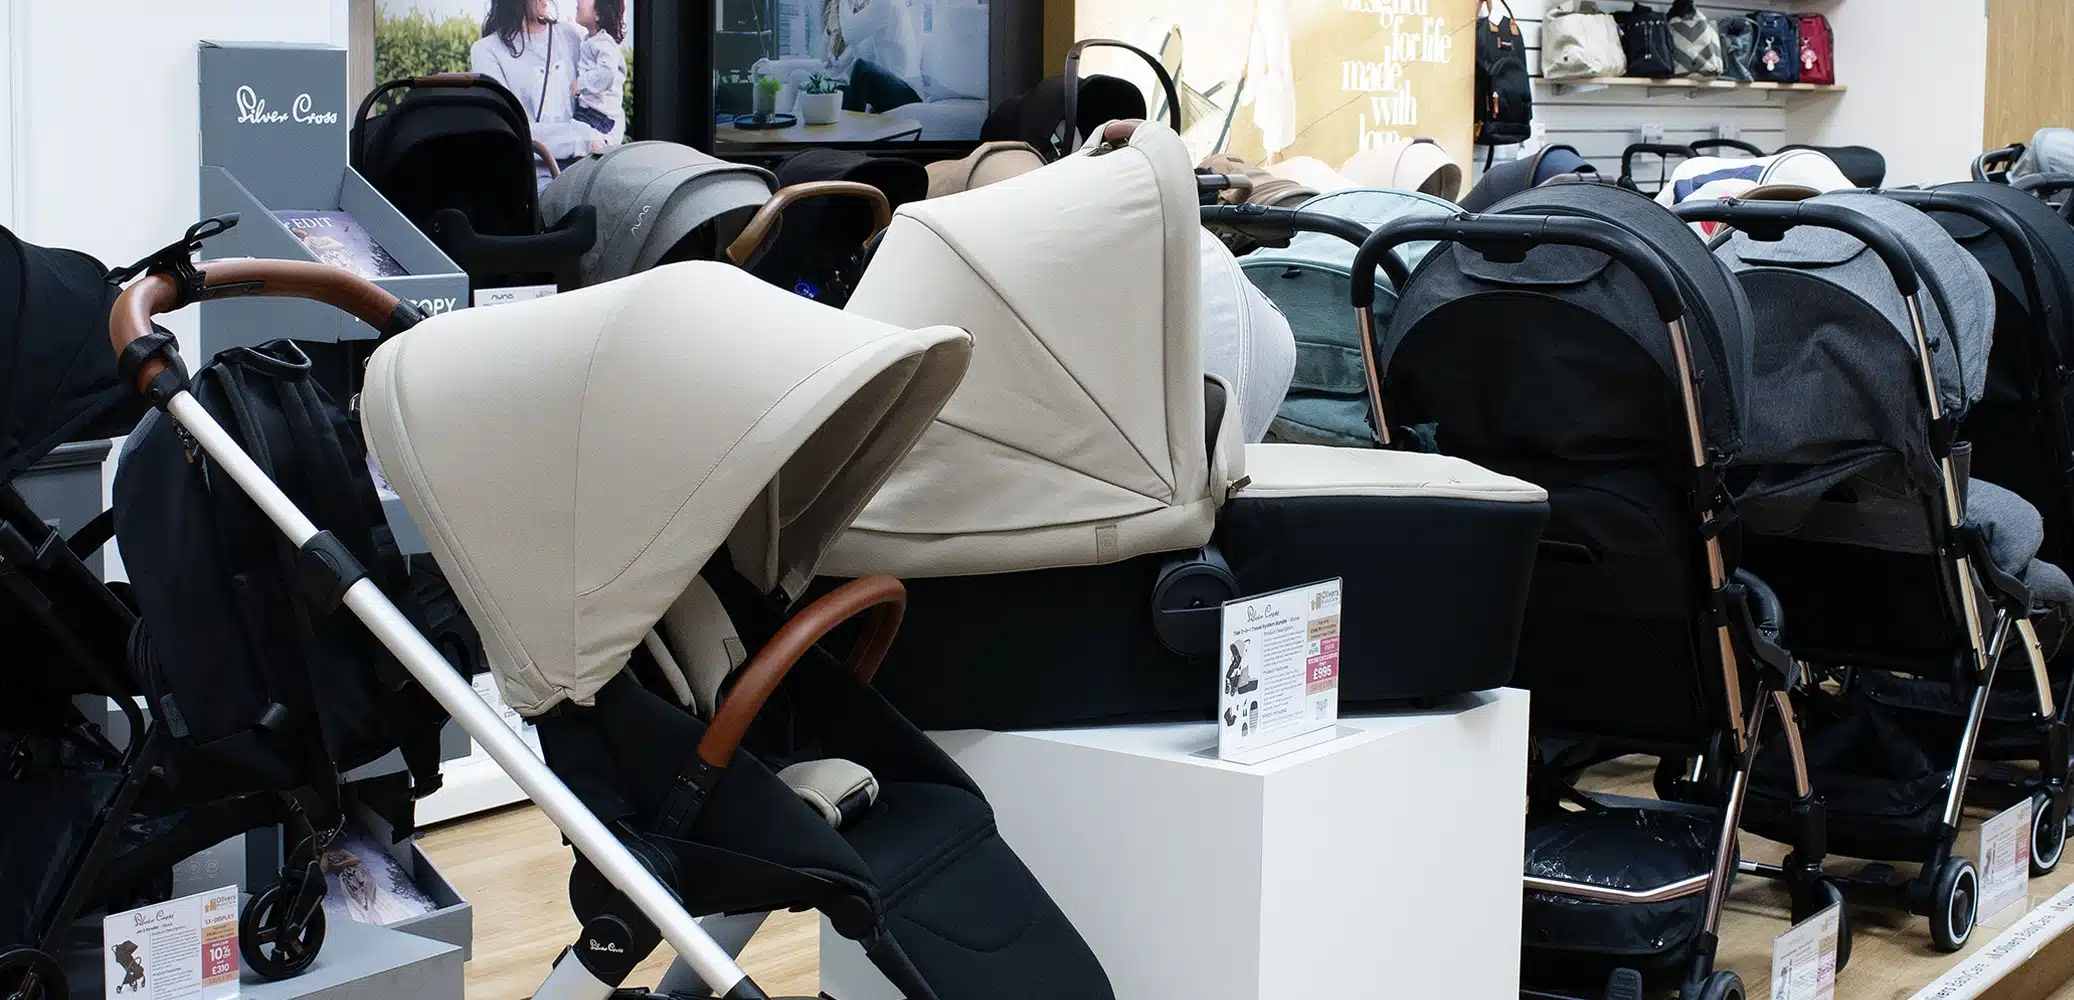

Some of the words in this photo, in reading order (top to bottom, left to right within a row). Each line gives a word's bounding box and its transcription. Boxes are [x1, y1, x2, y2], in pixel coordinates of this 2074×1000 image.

[1391, 14, 1420, 62] for
[1420, 16, 1452, 63] life
[1341, 45, 1401, 92] made
[236, 85, 289, 124] Silver
[293, 93, 338, 124] Cross
[1371, 80, 1417, 126] with
[291, 217, 332, 229] EDIT
[631, 205, 651, 236] nuna
[1246, 605, 1264, 623] Silver
[1264, 604, 1280, 618] Cross
[1313, 665, 1332, 680] £995
[134, 912, 155, 928] Silver
[155, 909, 174, 921] Cross
[212, 963, 230, 975] £310
